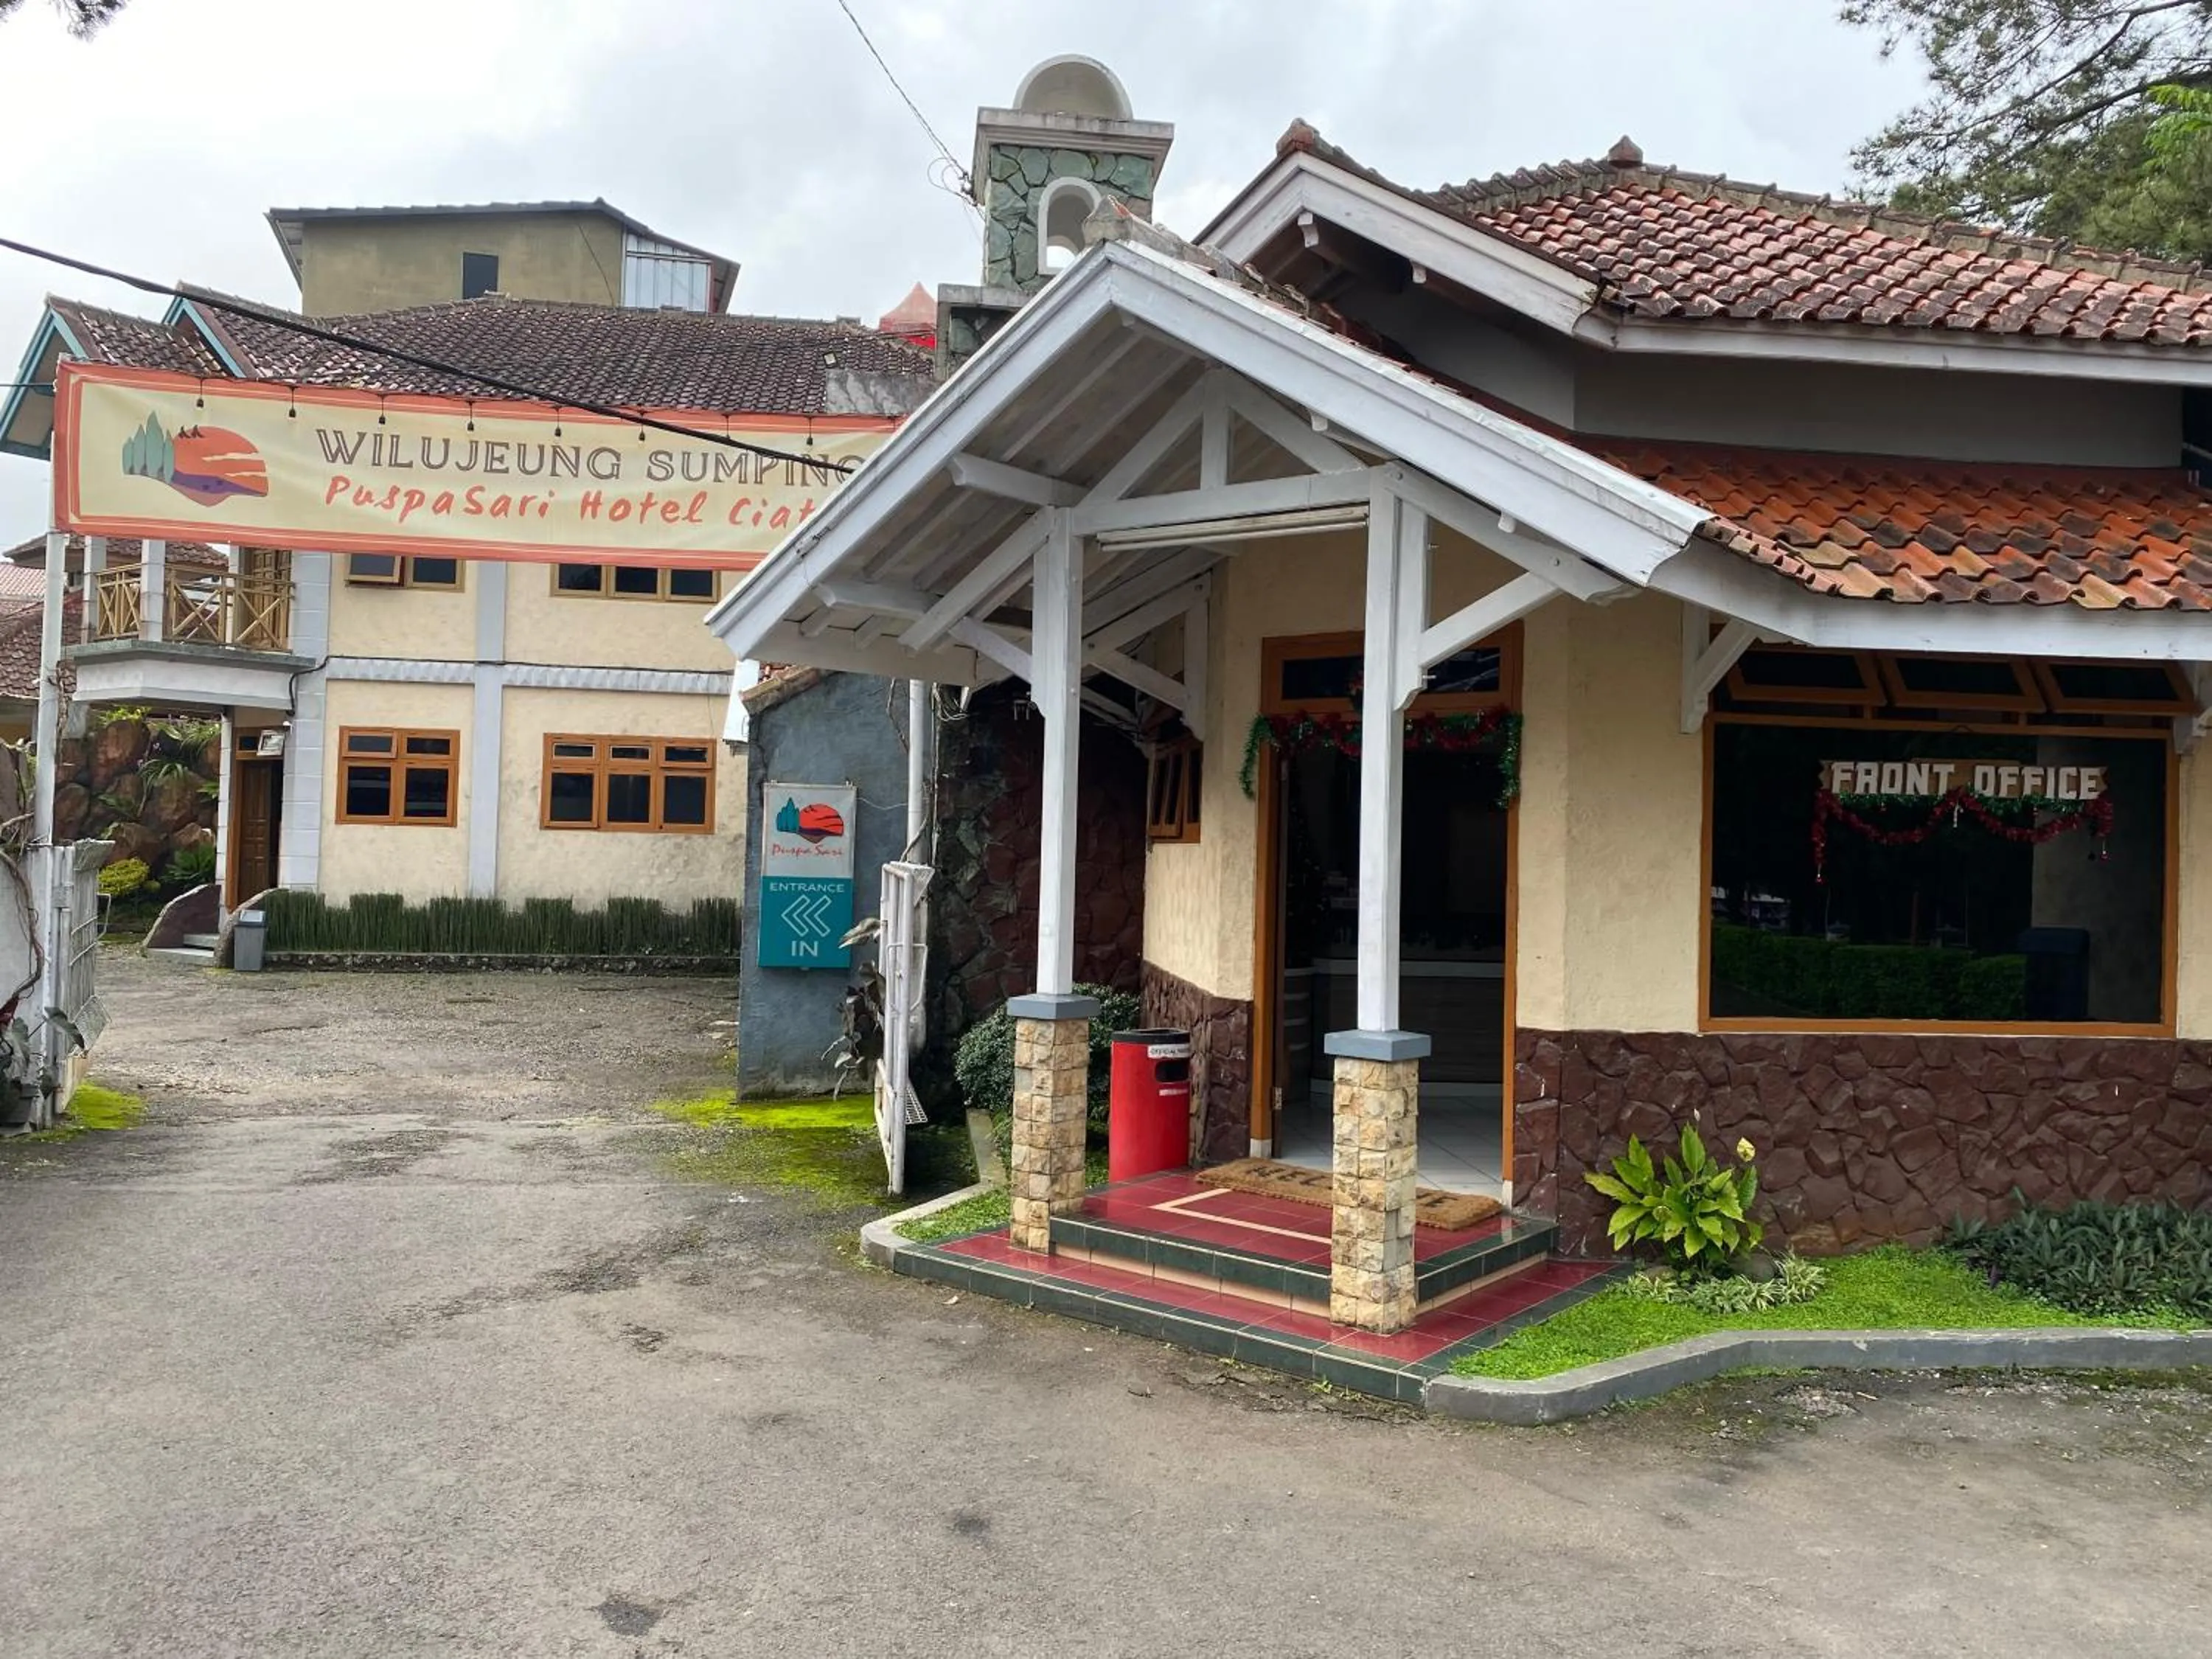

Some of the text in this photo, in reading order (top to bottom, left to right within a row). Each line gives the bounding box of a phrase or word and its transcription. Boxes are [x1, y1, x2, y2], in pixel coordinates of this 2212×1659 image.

[316, 428, 621, 480] WILUJEUNG
[325, 475, 554, 524] PuspaSari
[580, 489, 708, 524] Hotel
[1832, 762, 2101, 800] FRONT OFFICE
[770, 882, 845, 893] ENTRANCE
[791, 941, 818, 957] IN
